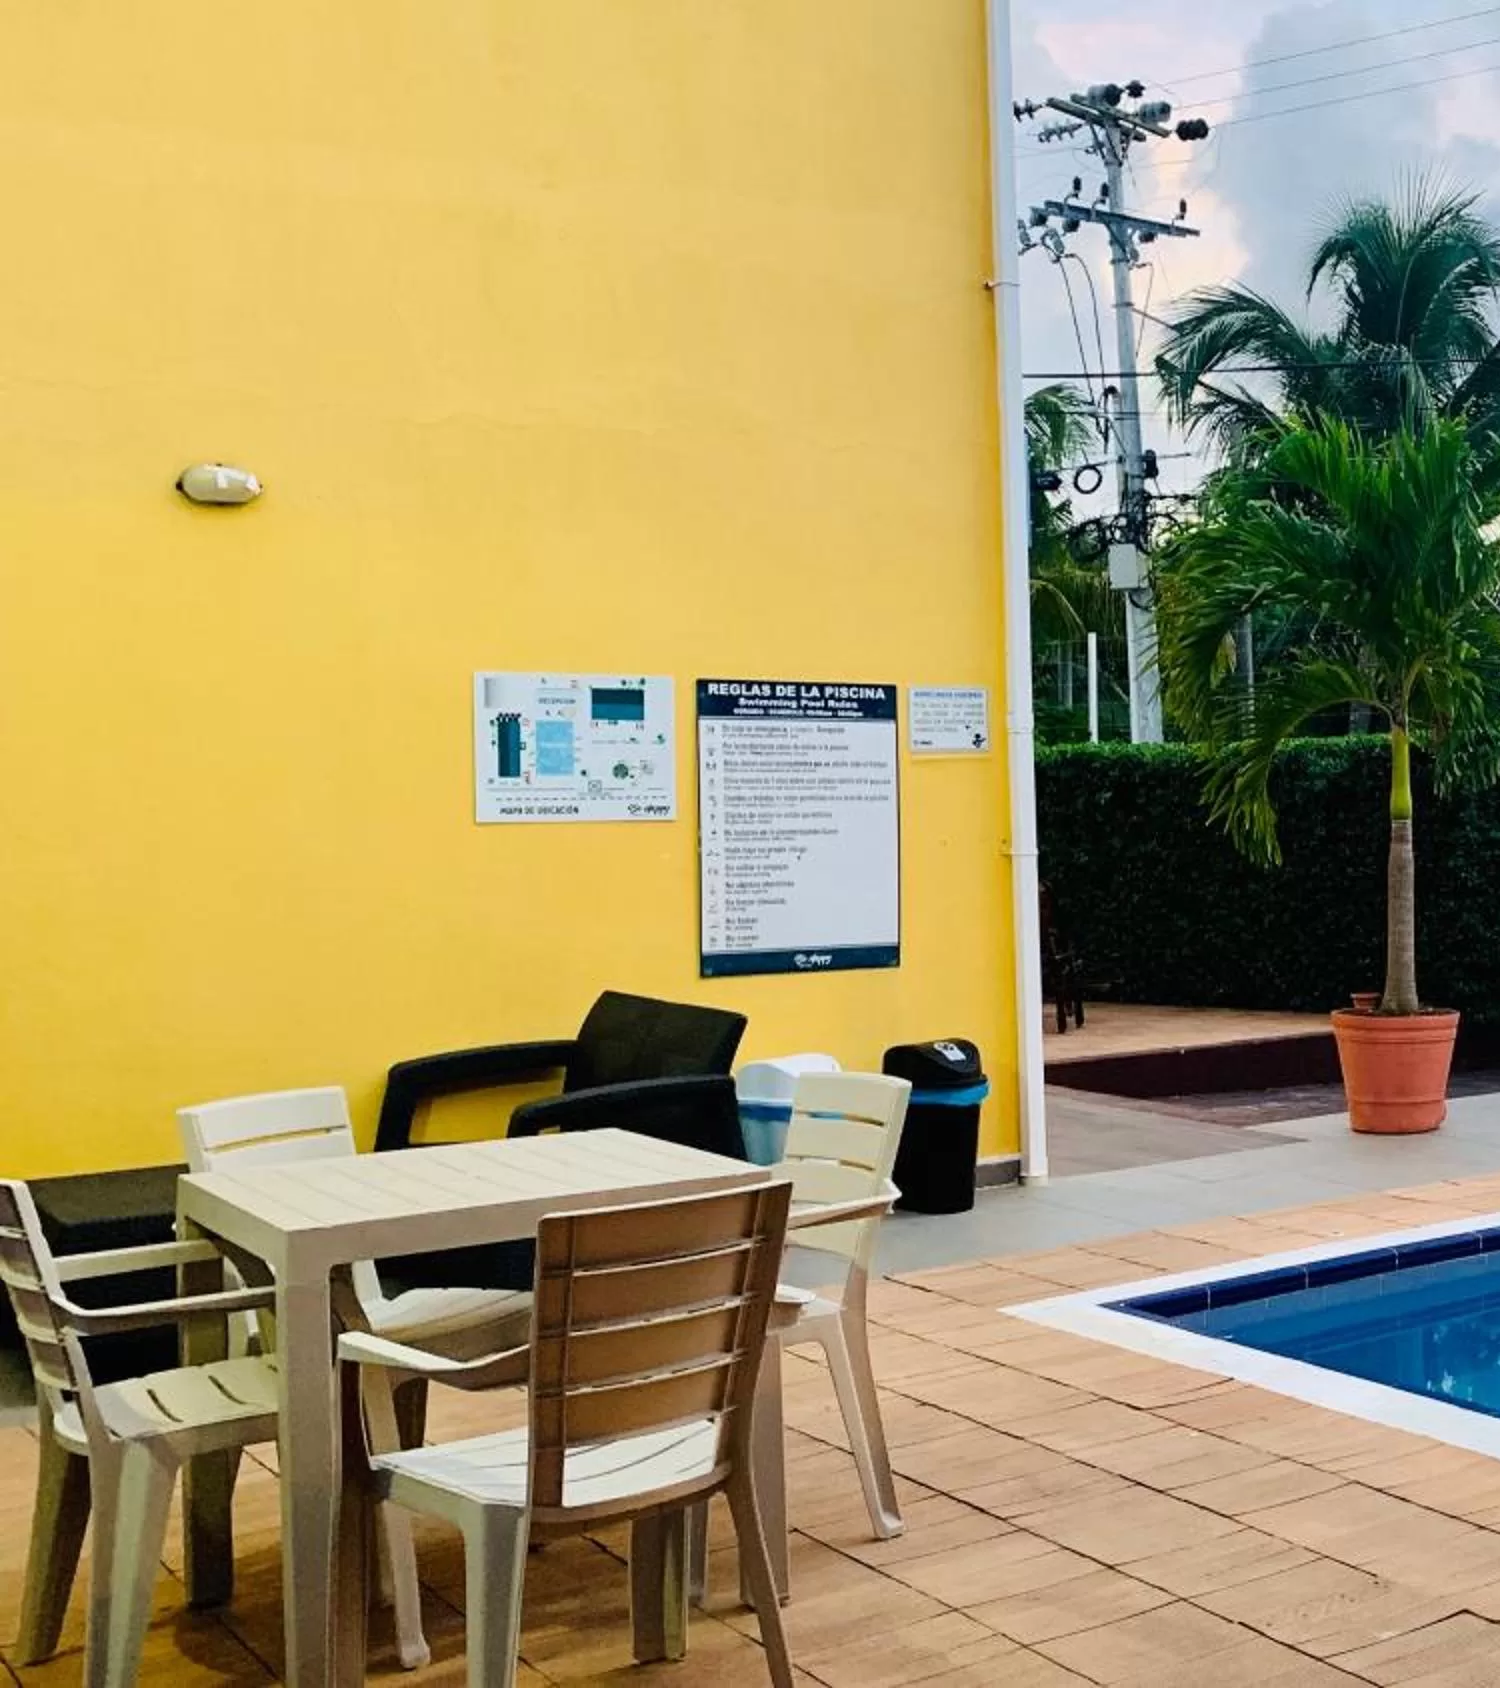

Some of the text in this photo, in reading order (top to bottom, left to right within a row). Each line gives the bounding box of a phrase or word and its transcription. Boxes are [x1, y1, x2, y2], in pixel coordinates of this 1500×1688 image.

[708, 683, 886, 700] REGLAS DE LA PISCINA
[738, 697, 798, 709] Swimming
[800, 699, 825, 708] Pool
